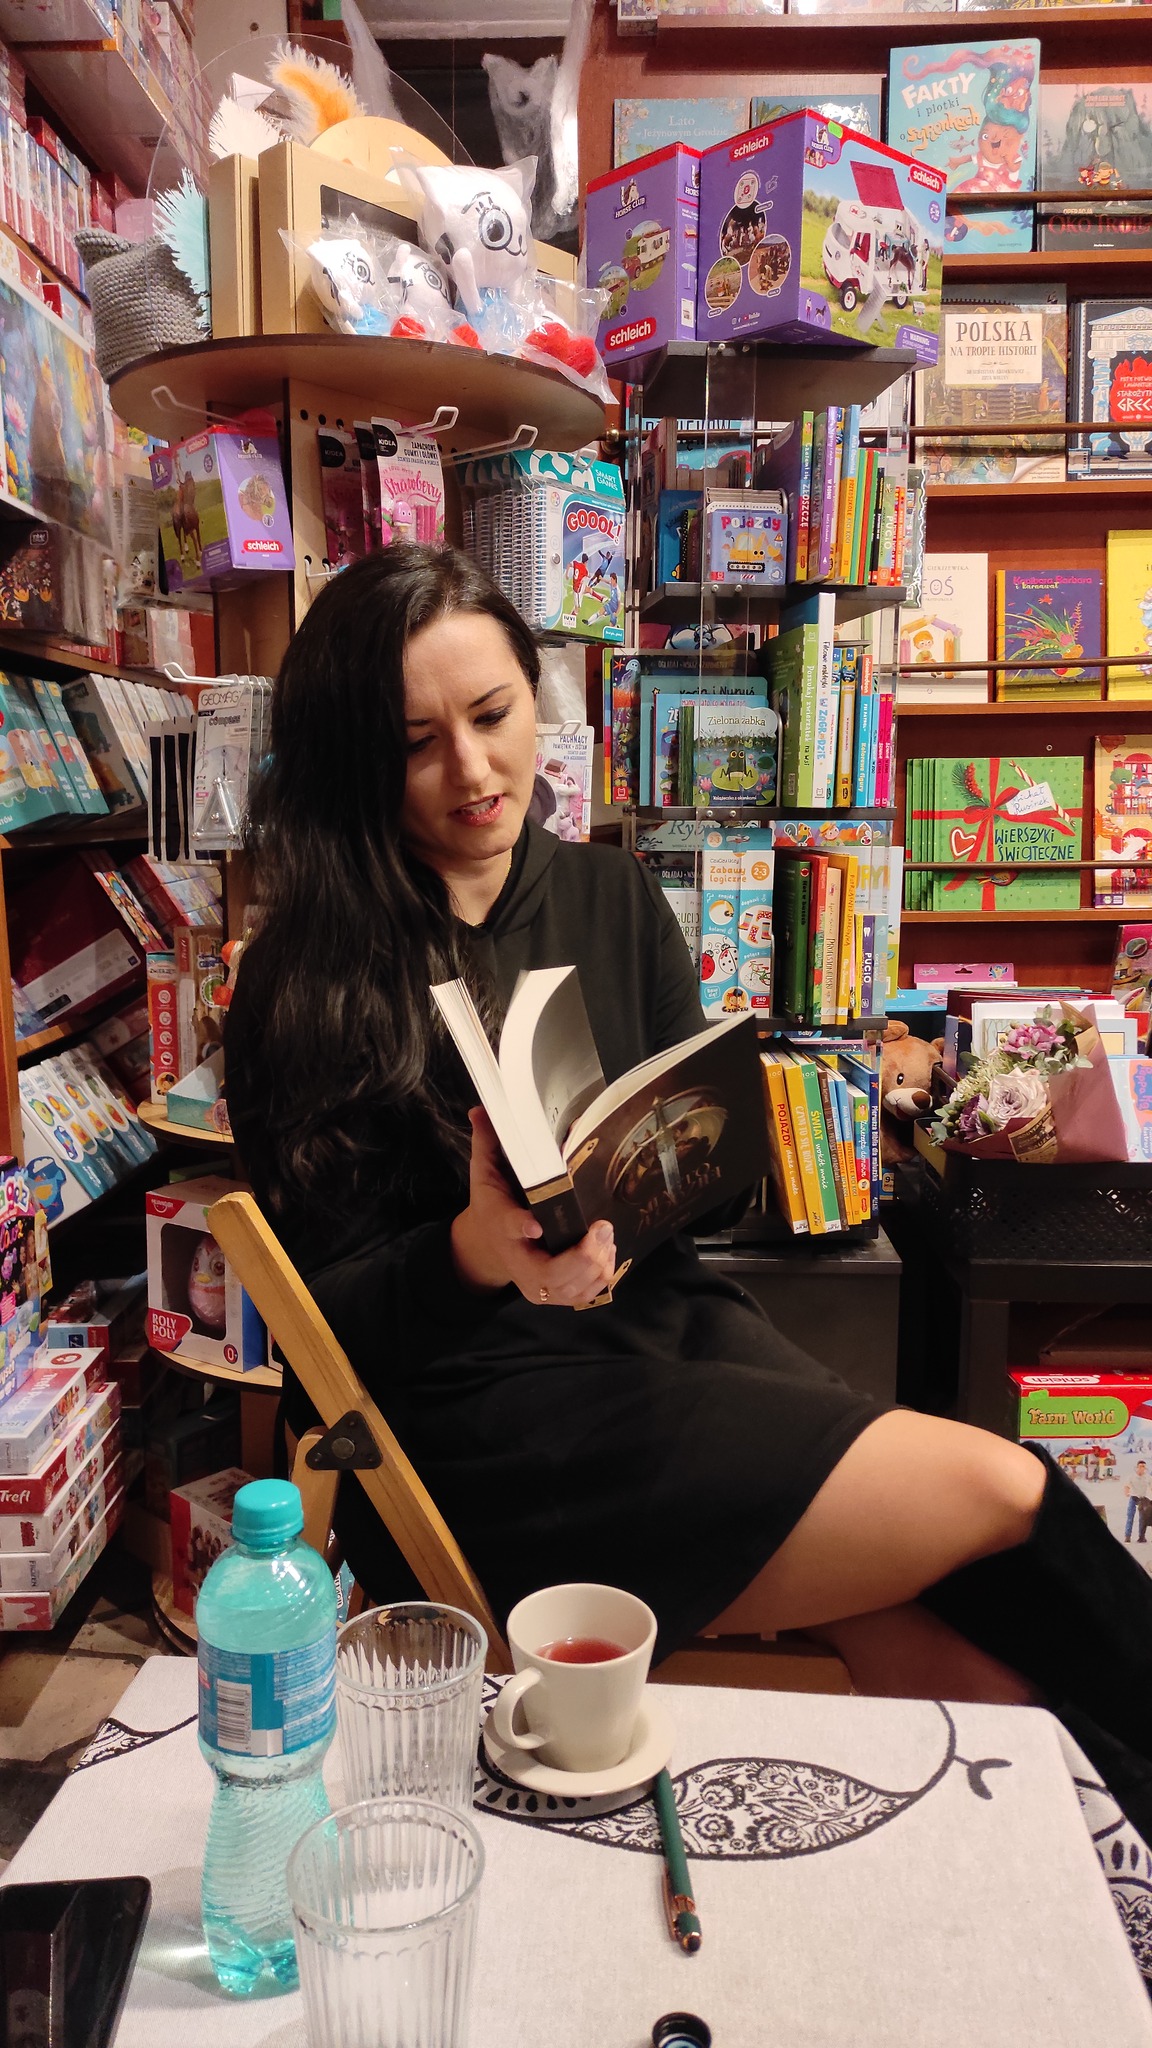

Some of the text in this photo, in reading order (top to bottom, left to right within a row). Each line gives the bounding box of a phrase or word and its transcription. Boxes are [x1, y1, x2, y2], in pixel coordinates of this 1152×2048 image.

[901, 72, 976, 110] FAKTY
[668, 115, 696, 126] Lato
[733, 135, 769, 158] schleich
[913, 169, 940, 190] schleich
[615, 197, 646, 219] HORSE CLUB
[610, 321, 651, 347] schleich
[955, 320, 1033, 343] POLSKA
[950, 346, 963, 357] NA
[966, 346, 996, 357] TROPIE
[998, 345, 1037, 356] HISTORII
[594, 468, 617, 484] SMART
[596, 476, 619, 492] GAMES
[383, 470, 442, 503] Strawberry
[566, 508, 622, 546] GOOOL!
[721, 515, 782, 530] Pojazdy
[247, 540, 280, 551] schleich
[201, 691, 239, 707] GEOMAG
[707, 714, 766, 727] Zielona żabka
[709, 865, 746, 876] Zabawy
[753, 867, 768, 876] 2-3
[709, 875, 747, 885] logiczne
[863, 952, 873, 984] PUCIO
[777, 1103, 792, 1147] POJAZDY
[810, 1110, 824, 1141] ŚWIAT
[152, 1313, 177, 1329] ROLY
[152, 1324, 177, 1341] POLY
[1033, 1376, 1090, 1384] schleich
[1028, 1408, 1117, 1425] Farm World
[0, 1489, 31, 1505] Trefl
